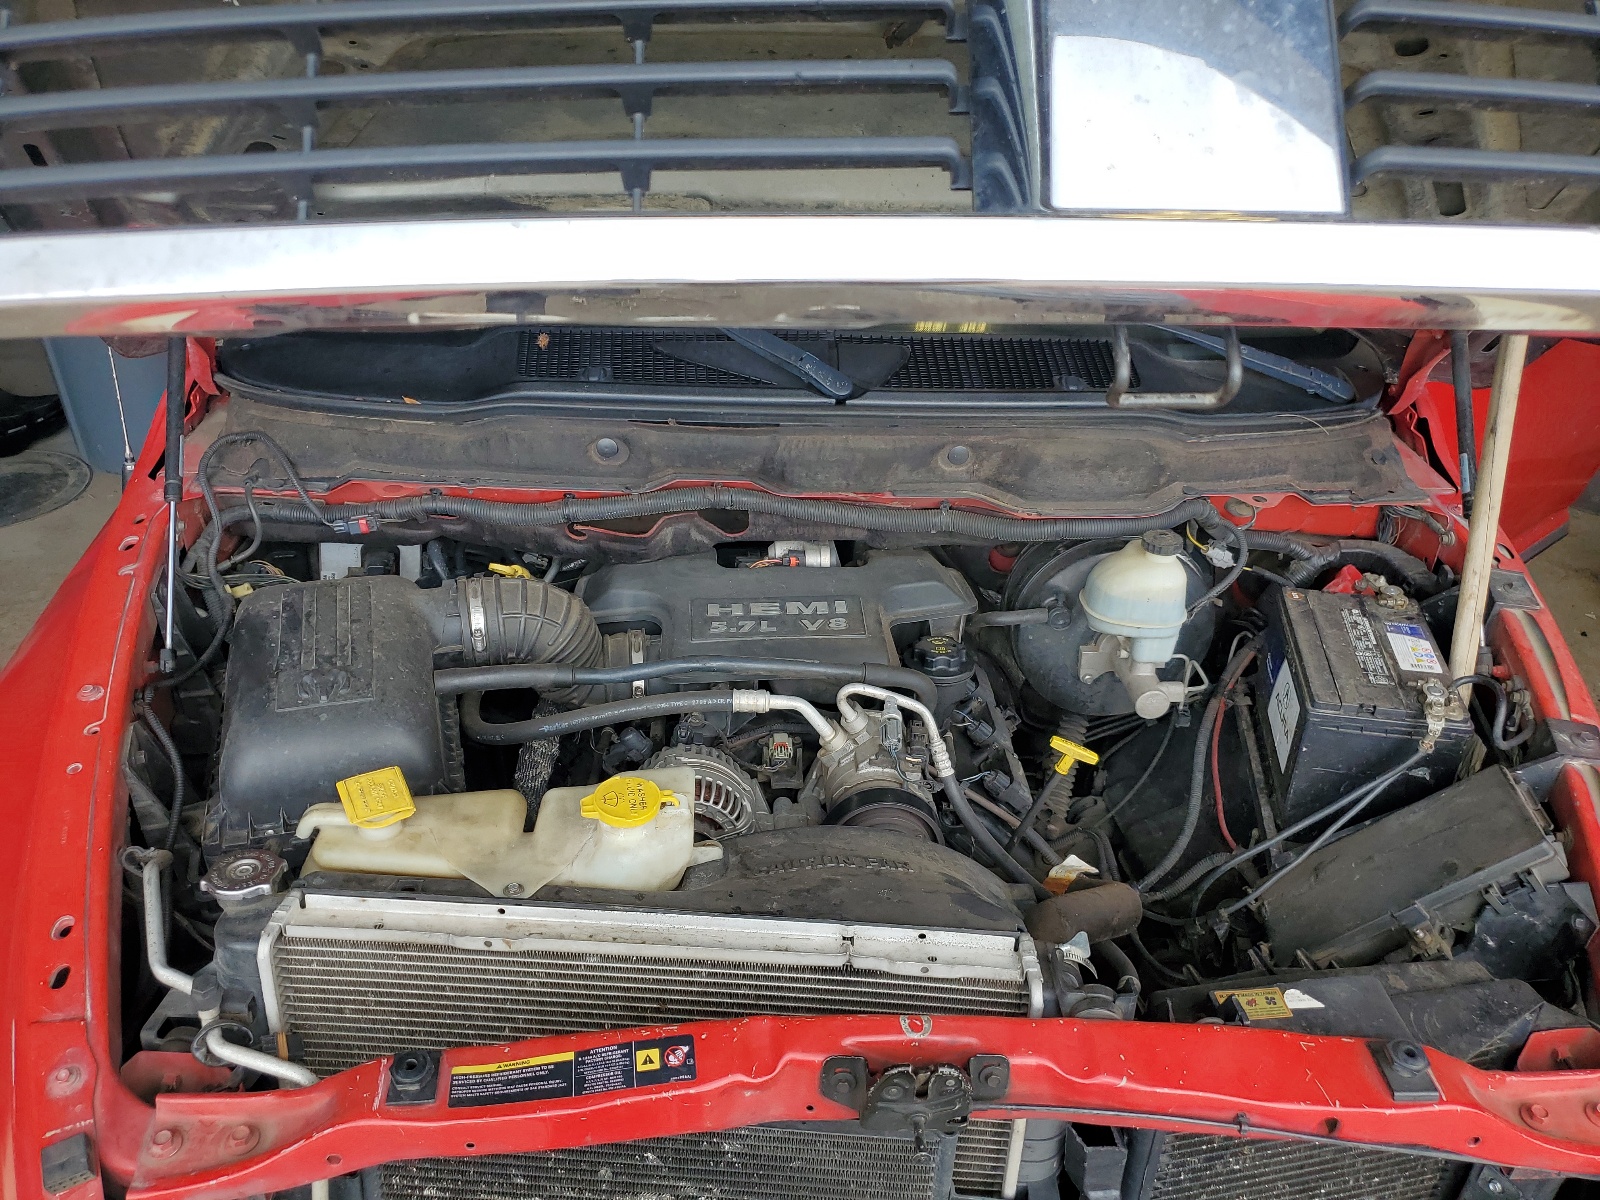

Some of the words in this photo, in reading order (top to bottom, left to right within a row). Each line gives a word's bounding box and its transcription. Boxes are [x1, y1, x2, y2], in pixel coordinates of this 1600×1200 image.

[706, 600, 848, 617] HEMI
[709, 619, 777, 634] 5.7L
[799, 617, 850, 632] V8
[636, 782, 647, 811] WASHER
[589, 1045, 618, 1055] ATTENTION
[503, 1059, 531, 1069] WARNING
